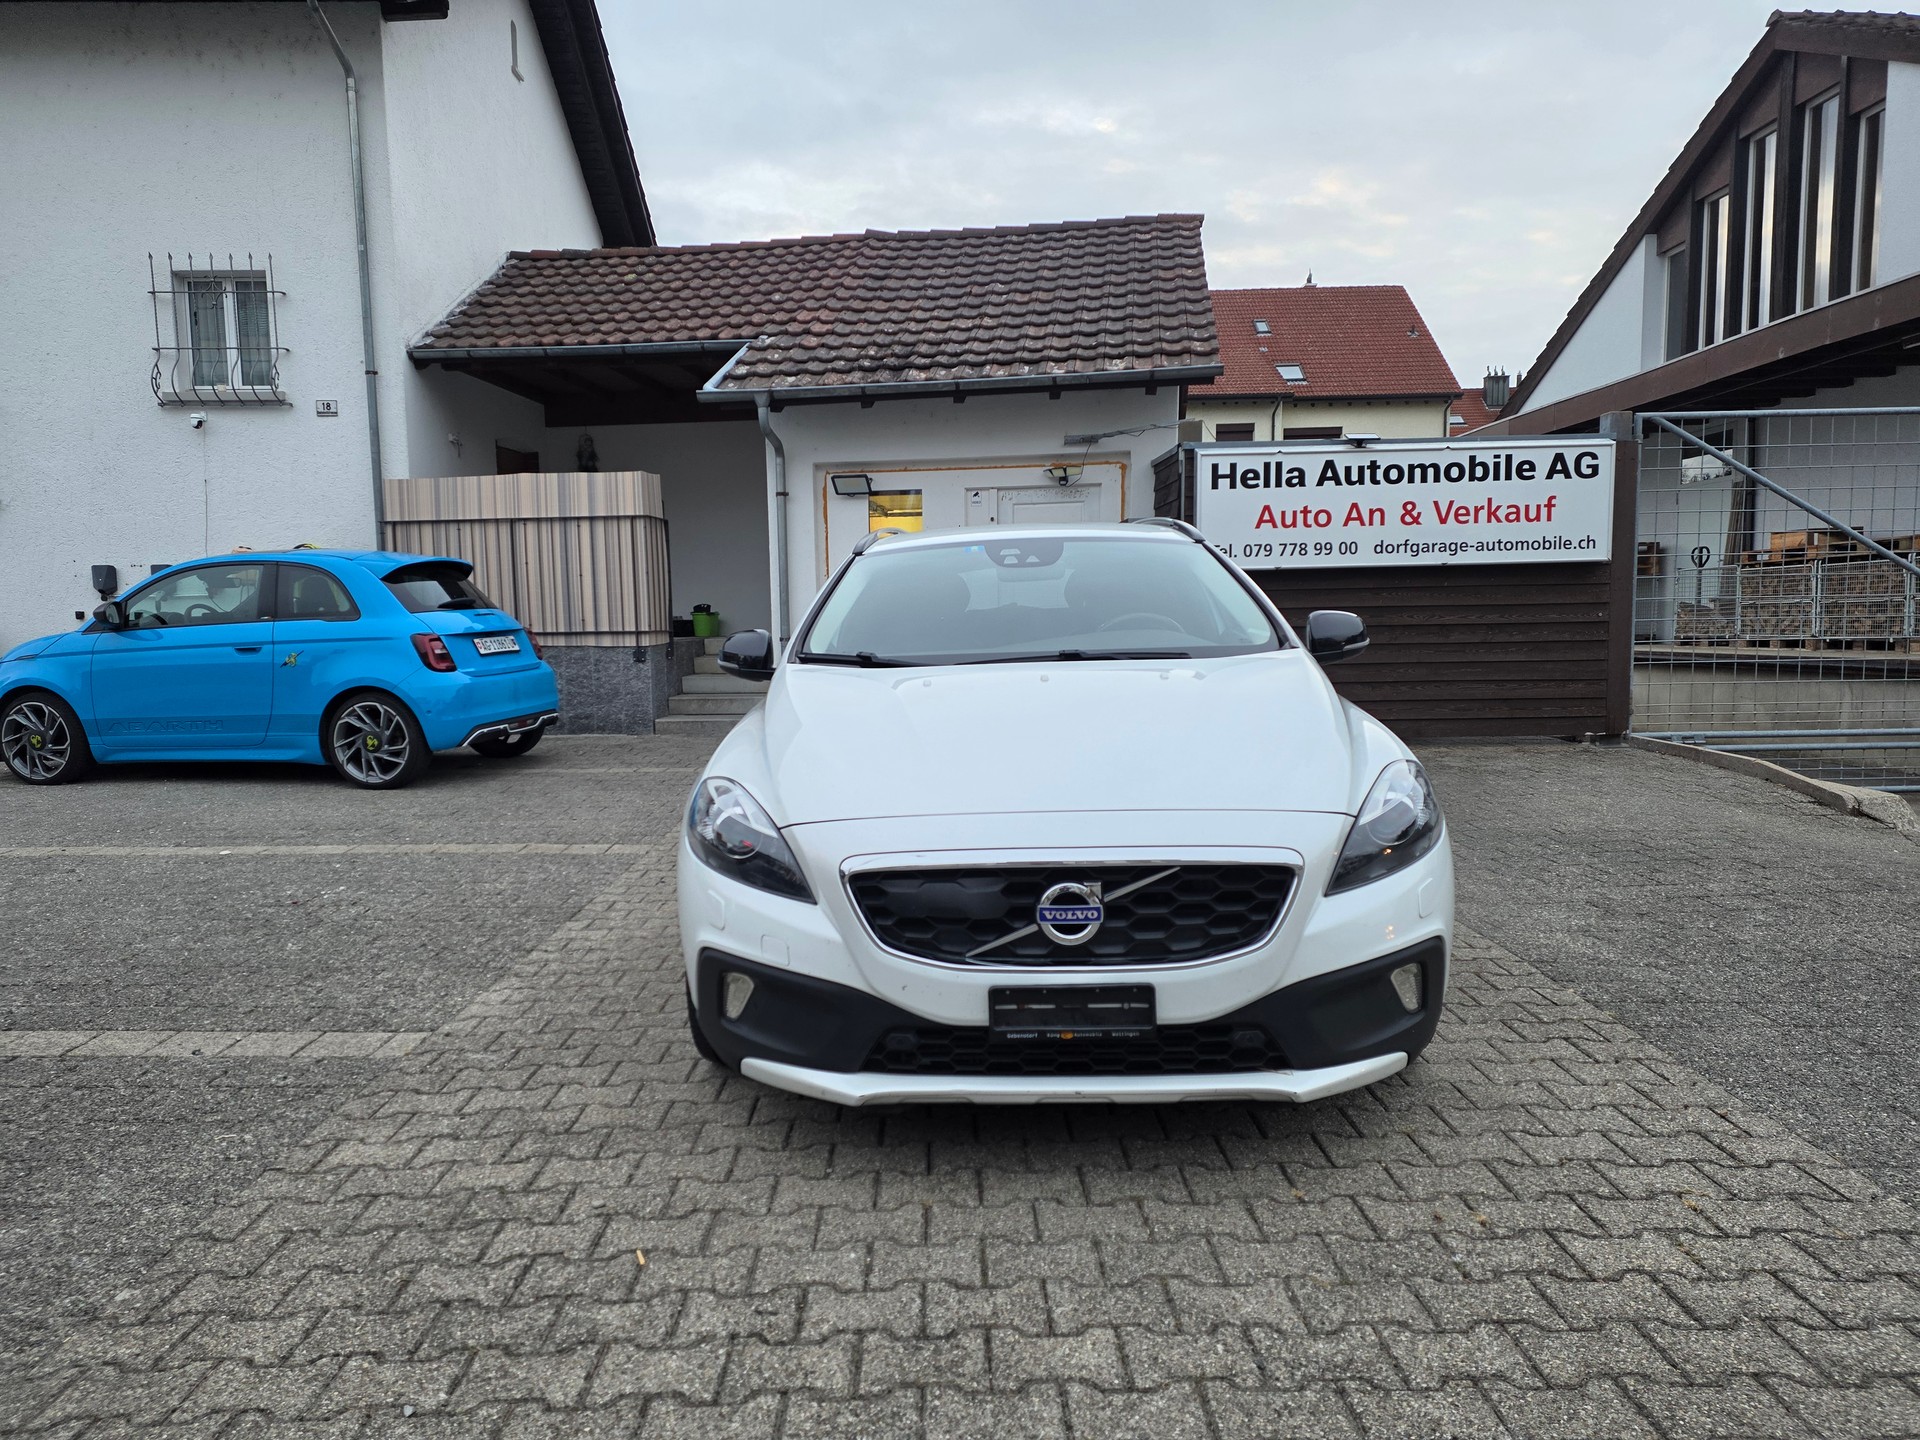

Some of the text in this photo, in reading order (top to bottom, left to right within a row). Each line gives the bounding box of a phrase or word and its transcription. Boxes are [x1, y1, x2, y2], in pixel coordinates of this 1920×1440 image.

[322, 402, 332, 411] 18
[1211, 451, 1600, 490] Hella Automobile AG
[1254, 495, 1557, 530] Auto An & Verkauf
[1243, 543, 1273, 558] 079
[1278, 542, 1308, 557] 778
[1313, 541, 1333, 556] 99
[1338, 541, 1358, 555] 00
[1373, 535, 1597, 557] dorfgarage-automobile.ch
[1042, 909, 1099, 920] VOLVO
